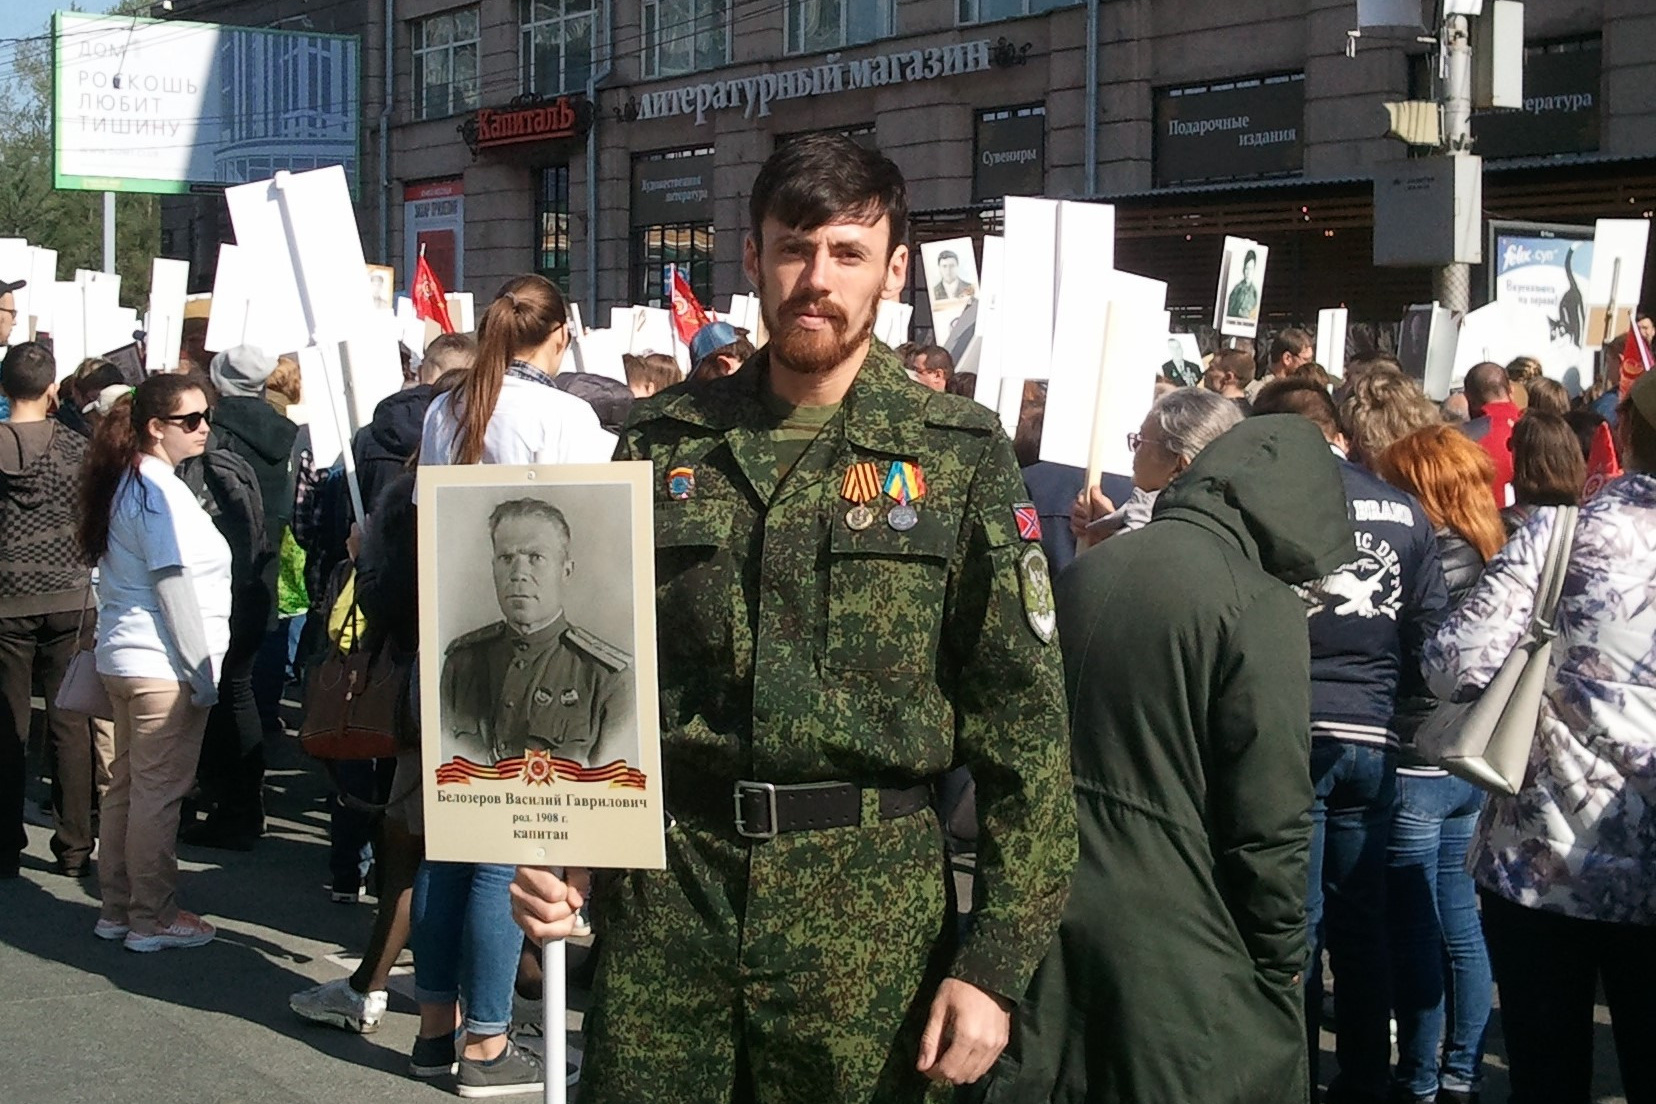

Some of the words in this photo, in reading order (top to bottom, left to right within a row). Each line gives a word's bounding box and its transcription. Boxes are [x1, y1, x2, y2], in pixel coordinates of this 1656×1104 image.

[636, 52, 845, 126] литературный
[848, 39, 992, 90] магазин
[78, 92, 162, 115] ЛЮБИТ
[79, 115, 181, 137] ТИШИНУ
[1168, 115, 1250, 136] Подарочные
[1238, 128, 1297, 146] издания
[981, 149, 1038, 167] Сувениры
[437, 790, 501, 807] Белозеров
[505, 791, 562, 807] Василий
[566, 793, 648, 810] Гаврилович
[535, 812, 559, 824] 1908
[513, 829, 569, 840] капитан
